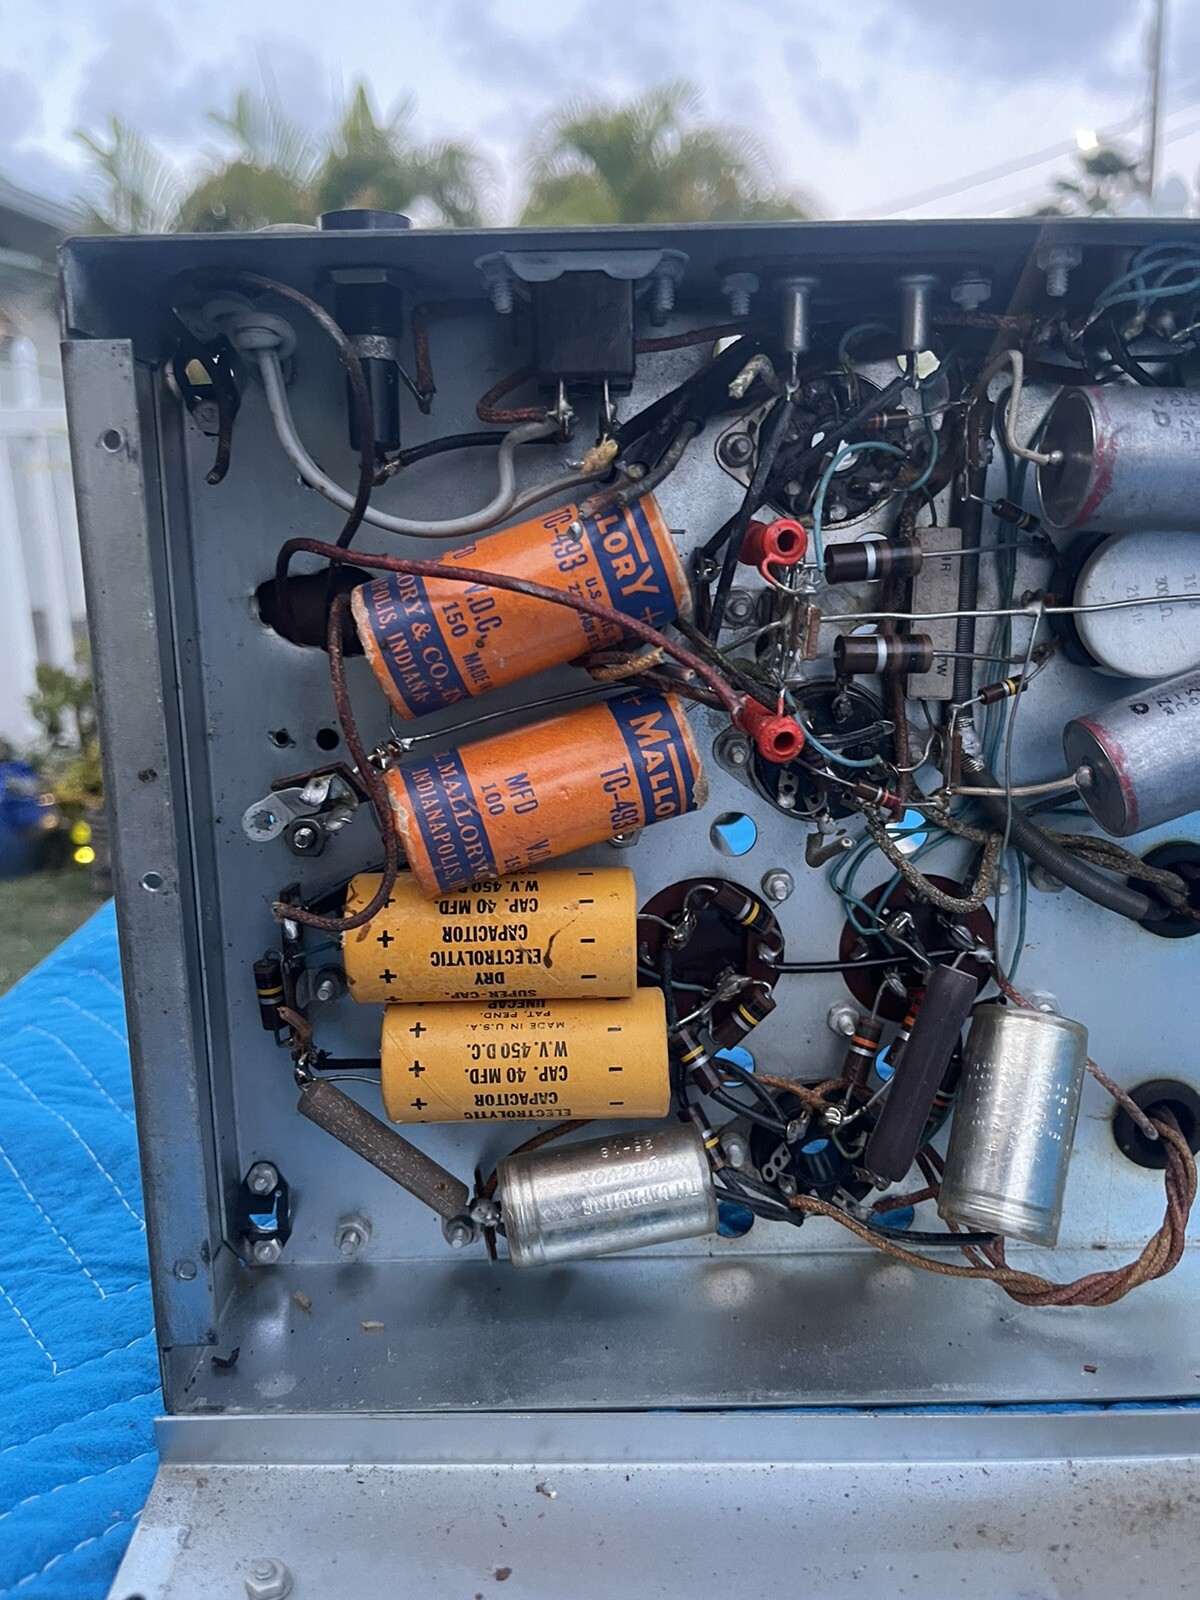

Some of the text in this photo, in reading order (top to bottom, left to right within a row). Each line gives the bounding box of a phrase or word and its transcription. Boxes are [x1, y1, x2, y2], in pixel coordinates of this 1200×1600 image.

[594, 513, 660, 597] LORY
[411, 622, 432, 642] &
[442, 602, 468, 637] 150
[463, 652, 490, 685] MADE
[387, 632, 430, 703] INDIANA
[480, 783, 505, 816] 100
[504, 772, 538, 815] MFD
[600, 762, 640, 831] TC-493
[471, 881, 502, 893] 450
[506, 880, 539, 892] W.V.
[434, 898, 538, 915] CAP. 40 MFD.
[442, 924, 528, 943] CAPACITOR
[430, 949, 542, 967] ELECTROLYTIC
[475, 972, 505, 985] DRY
[480, 1010, 551, 1019] PAT. PEND.
[466, 1021, 565, 1031] MADE IN U.S.A.
[467, 1041, 568, 1060] W.V. 450 D.C.
[464, 1065, 568, 1085] CAP. 40 MFD.
[474, 1092, 558, 1107] CAPACITOR
[464, 1109, 572, 1119] ELECTROLYTIC
